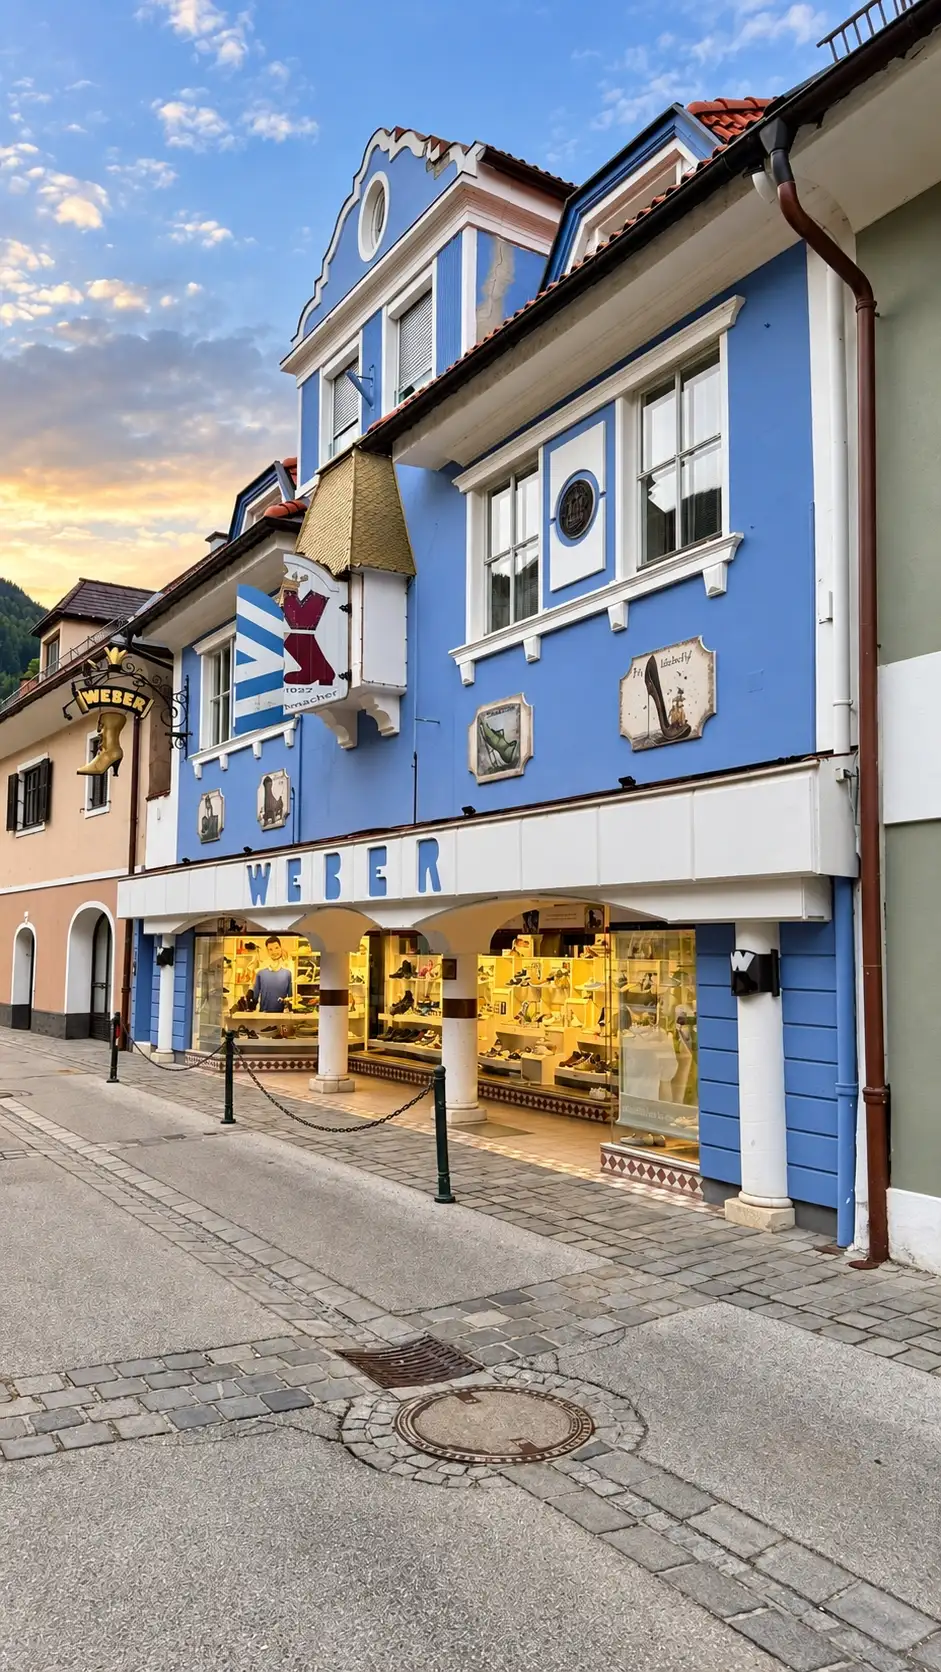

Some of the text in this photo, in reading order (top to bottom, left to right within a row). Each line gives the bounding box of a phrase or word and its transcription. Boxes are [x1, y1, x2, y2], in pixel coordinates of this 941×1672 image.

[82, 688, 146, 712] WEBER
[246, 838, 441, 906] WEBER
[731, 950, 755, 972] W
